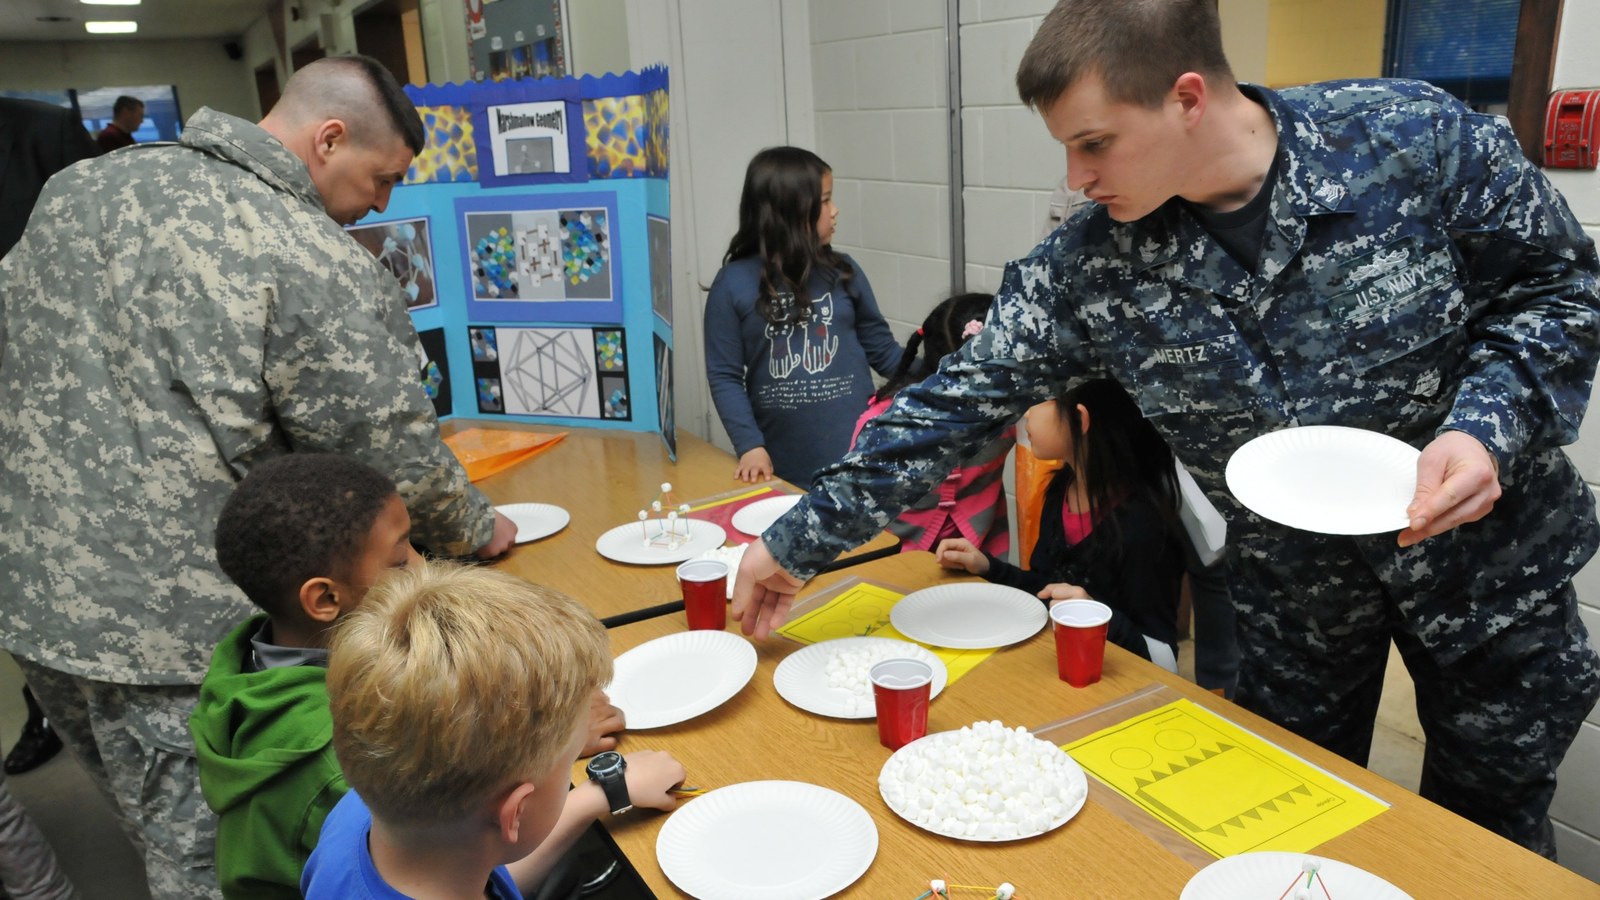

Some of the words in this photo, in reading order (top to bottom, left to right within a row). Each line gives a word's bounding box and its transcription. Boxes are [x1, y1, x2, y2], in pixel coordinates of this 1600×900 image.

[496, 108, 534, 134] Marshmallow
[536, 108, 563, 134] Geometry
[1356, 287, 1386, 307] U.S.
[1387, 264, 1426, 296] NAVY
[1154, 345, 1207, 364] MERTZ
